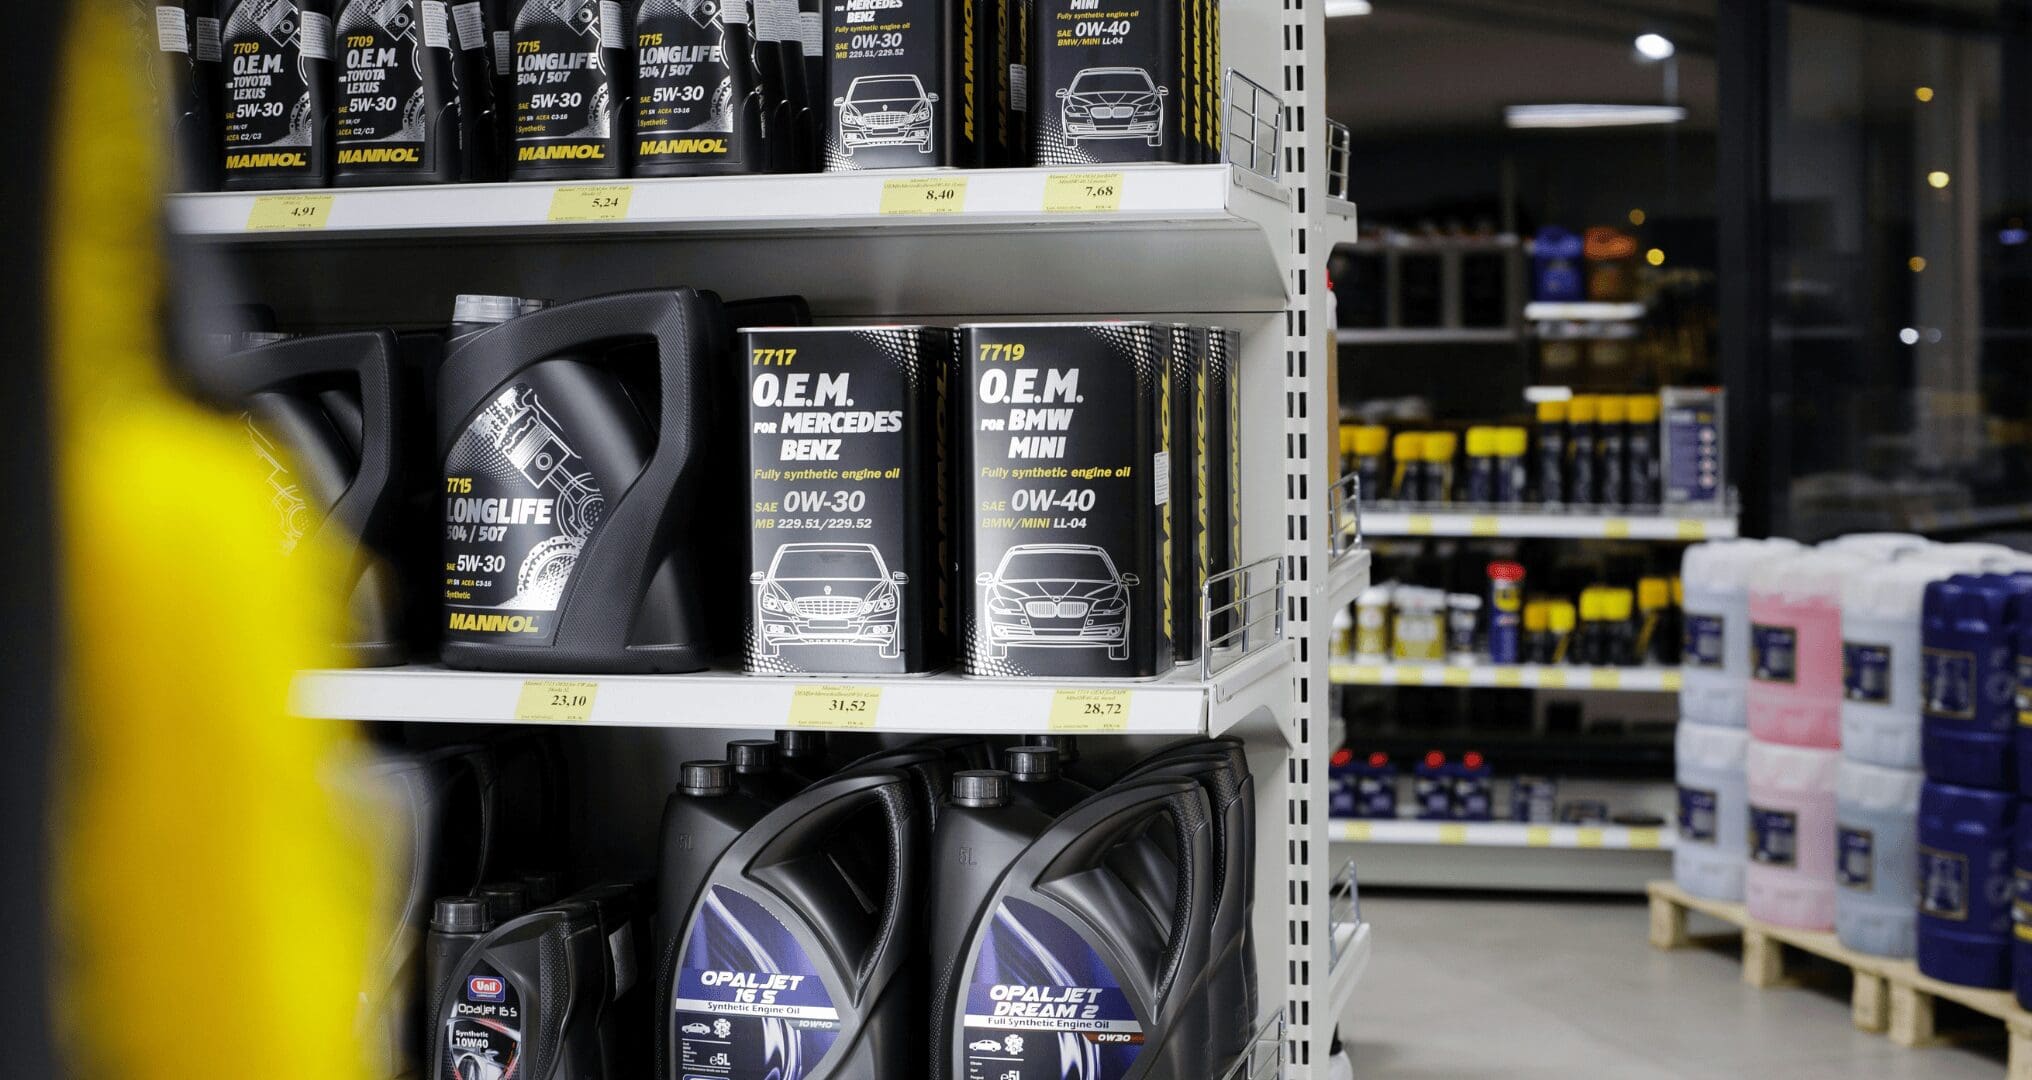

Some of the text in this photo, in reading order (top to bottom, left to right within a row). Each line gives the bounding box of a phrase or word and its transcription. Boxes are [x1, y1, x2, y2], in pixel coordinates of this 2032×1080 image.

[846, 0, 903, 11] MERCEDES
[1070, 0, 1100, 10] MINI
[846, 11, 875, 23] BENZ
[1106, 11, 1128, 19] engine
[880, 23, 900, 31] engine
[1075, 21, 1130, 36] 0W-40
[347, 36, 373, 47] 7709
[640, 33, 663, 46] 7715
[852, 33, 902, 49] 0W-30
[1058, 38, 1100, 47] BMW/MINI
[234, 42, 259, 54] 7709
[517, 41, 540, 53] 7715
[346, 48, 398, 69] O.E.M.
[517, 52, 598, 72] LONGLIFE
[640, 45, 720, 66] LONGLIFE
[233, 54, 284, 75] O.E.M.
[347, 69, 385, 81] TOYOTA
[517, 71, 570, 85] 504 / 507
[640, 64, 693, 79] 504 / 507
[234, 75, 271, 88] TOYOTA
[347, 82, 380, 94] LEXUS
[234, 88, 266, 100] LEXUS
[530, 92, 582, 108] 5W-30
[653, 86, 704, 102] 5W-30
[236, 102, 283, 118] 5W-30
[349, 97, 397, 112] 5W-30
[640, 118, 668, 127] Synthetic
[518, 125, 546, 134] Synthetic
[518, 145, 604, 161] MANNOL
[640, 139, 727, 155] MANNOL
[226, 153, 306, 168] MANNOL
[338, 148, 419, 164] MANNOL
[926, 190, 954, 201] 8,40
[1086, 186, 1113, 197] 7,68
[592, 198, 618, 207] 5,24
[752, 349, 796, 366] 7717
[980, 344, 1025, 361] 7719
[752, 372, 854, 407] O.E.M.
[979, 368, 1084, 404] O.E.M.
[754, 411, 902, 434] FOR MERCEDES
[981, 408, 1073, 431] FOR BMW
[780, 439, 842, 461] BENZ
[1008, 436, 1066, 458] MINI
[754, 468, 900, 481] Fully synthetic engine oil
[981, 466, 1131, 479] Fully synthetic engine oil
[448, 478, 472, 493] 7715
[755, 490, 865, 513] SAE 0W-30
[982, 488, 1095, 513] SAE 0W-40
[446, 498, 554, 524] LONGLIFE
[755, 518, 872, 530] MB 229.51/229.52
[982, 518, 1087, 529] BMW/MINI LL-04
[447, 525, 508, 543] 504 / 507
[457, 555, 505, 572] 5W-30
[446, 590, 470, 600] Synthetic
[450, 613, 539, 633] MANNOL
[551, 695, 586, 706] 23,10
[829, 700, 866, 713] 31,52
[1084, 703, 1121, 715] 28,72
[476, 981, 496, 991] Unil
[701, 971, 805, 991] OPALJET
[734, 989, 778, 1005] 16 S
[990, 985, 1103, 1004] OPALJET
[458, 1004, 517, 1017] Opaljet 16 S
[708, 1002, 749, 1012] Synthetic
[752, 1006, 783, 1015] Engine
[994, 1002, 1099, 1019] DREAM 2
[798, 1020, 833, 1028] 10W40
[988, 1017, 1006, 1025] Full
[1008, 1018, 1054, 1029] Synthetic
[1057, 1021, 1092, 1030] Engine
[456, 1030, 488, 1038] Synthetic
[1098, 1034, 1131, 1042] 0W30
[456, 1038, 489, 1048] 10W40
